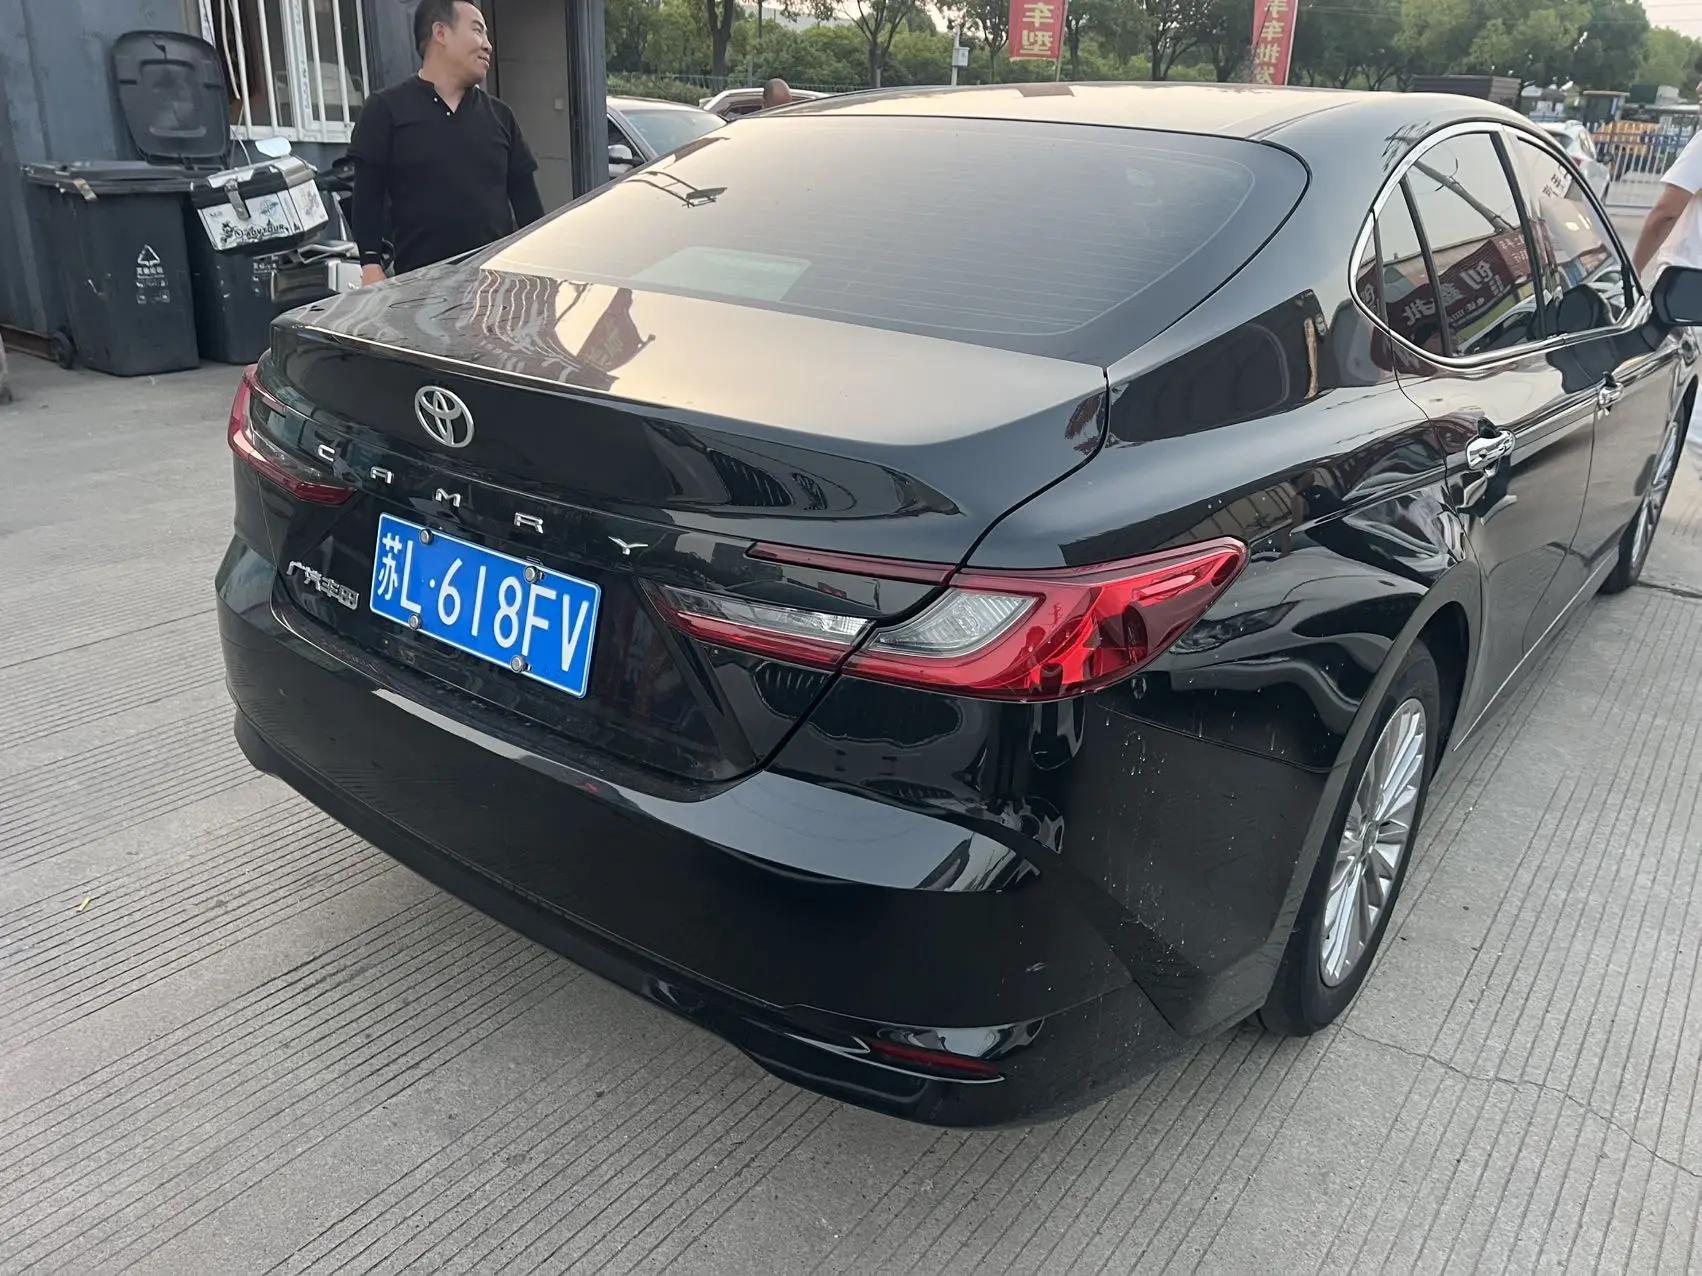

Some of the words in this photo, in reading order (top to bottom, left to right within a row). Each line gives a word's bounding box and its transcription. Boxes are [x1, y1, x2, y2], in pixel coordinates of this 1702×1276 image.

[318, 444, 648, 556] CAMRY
[286, 560, 360, 610] 广汽丰田
